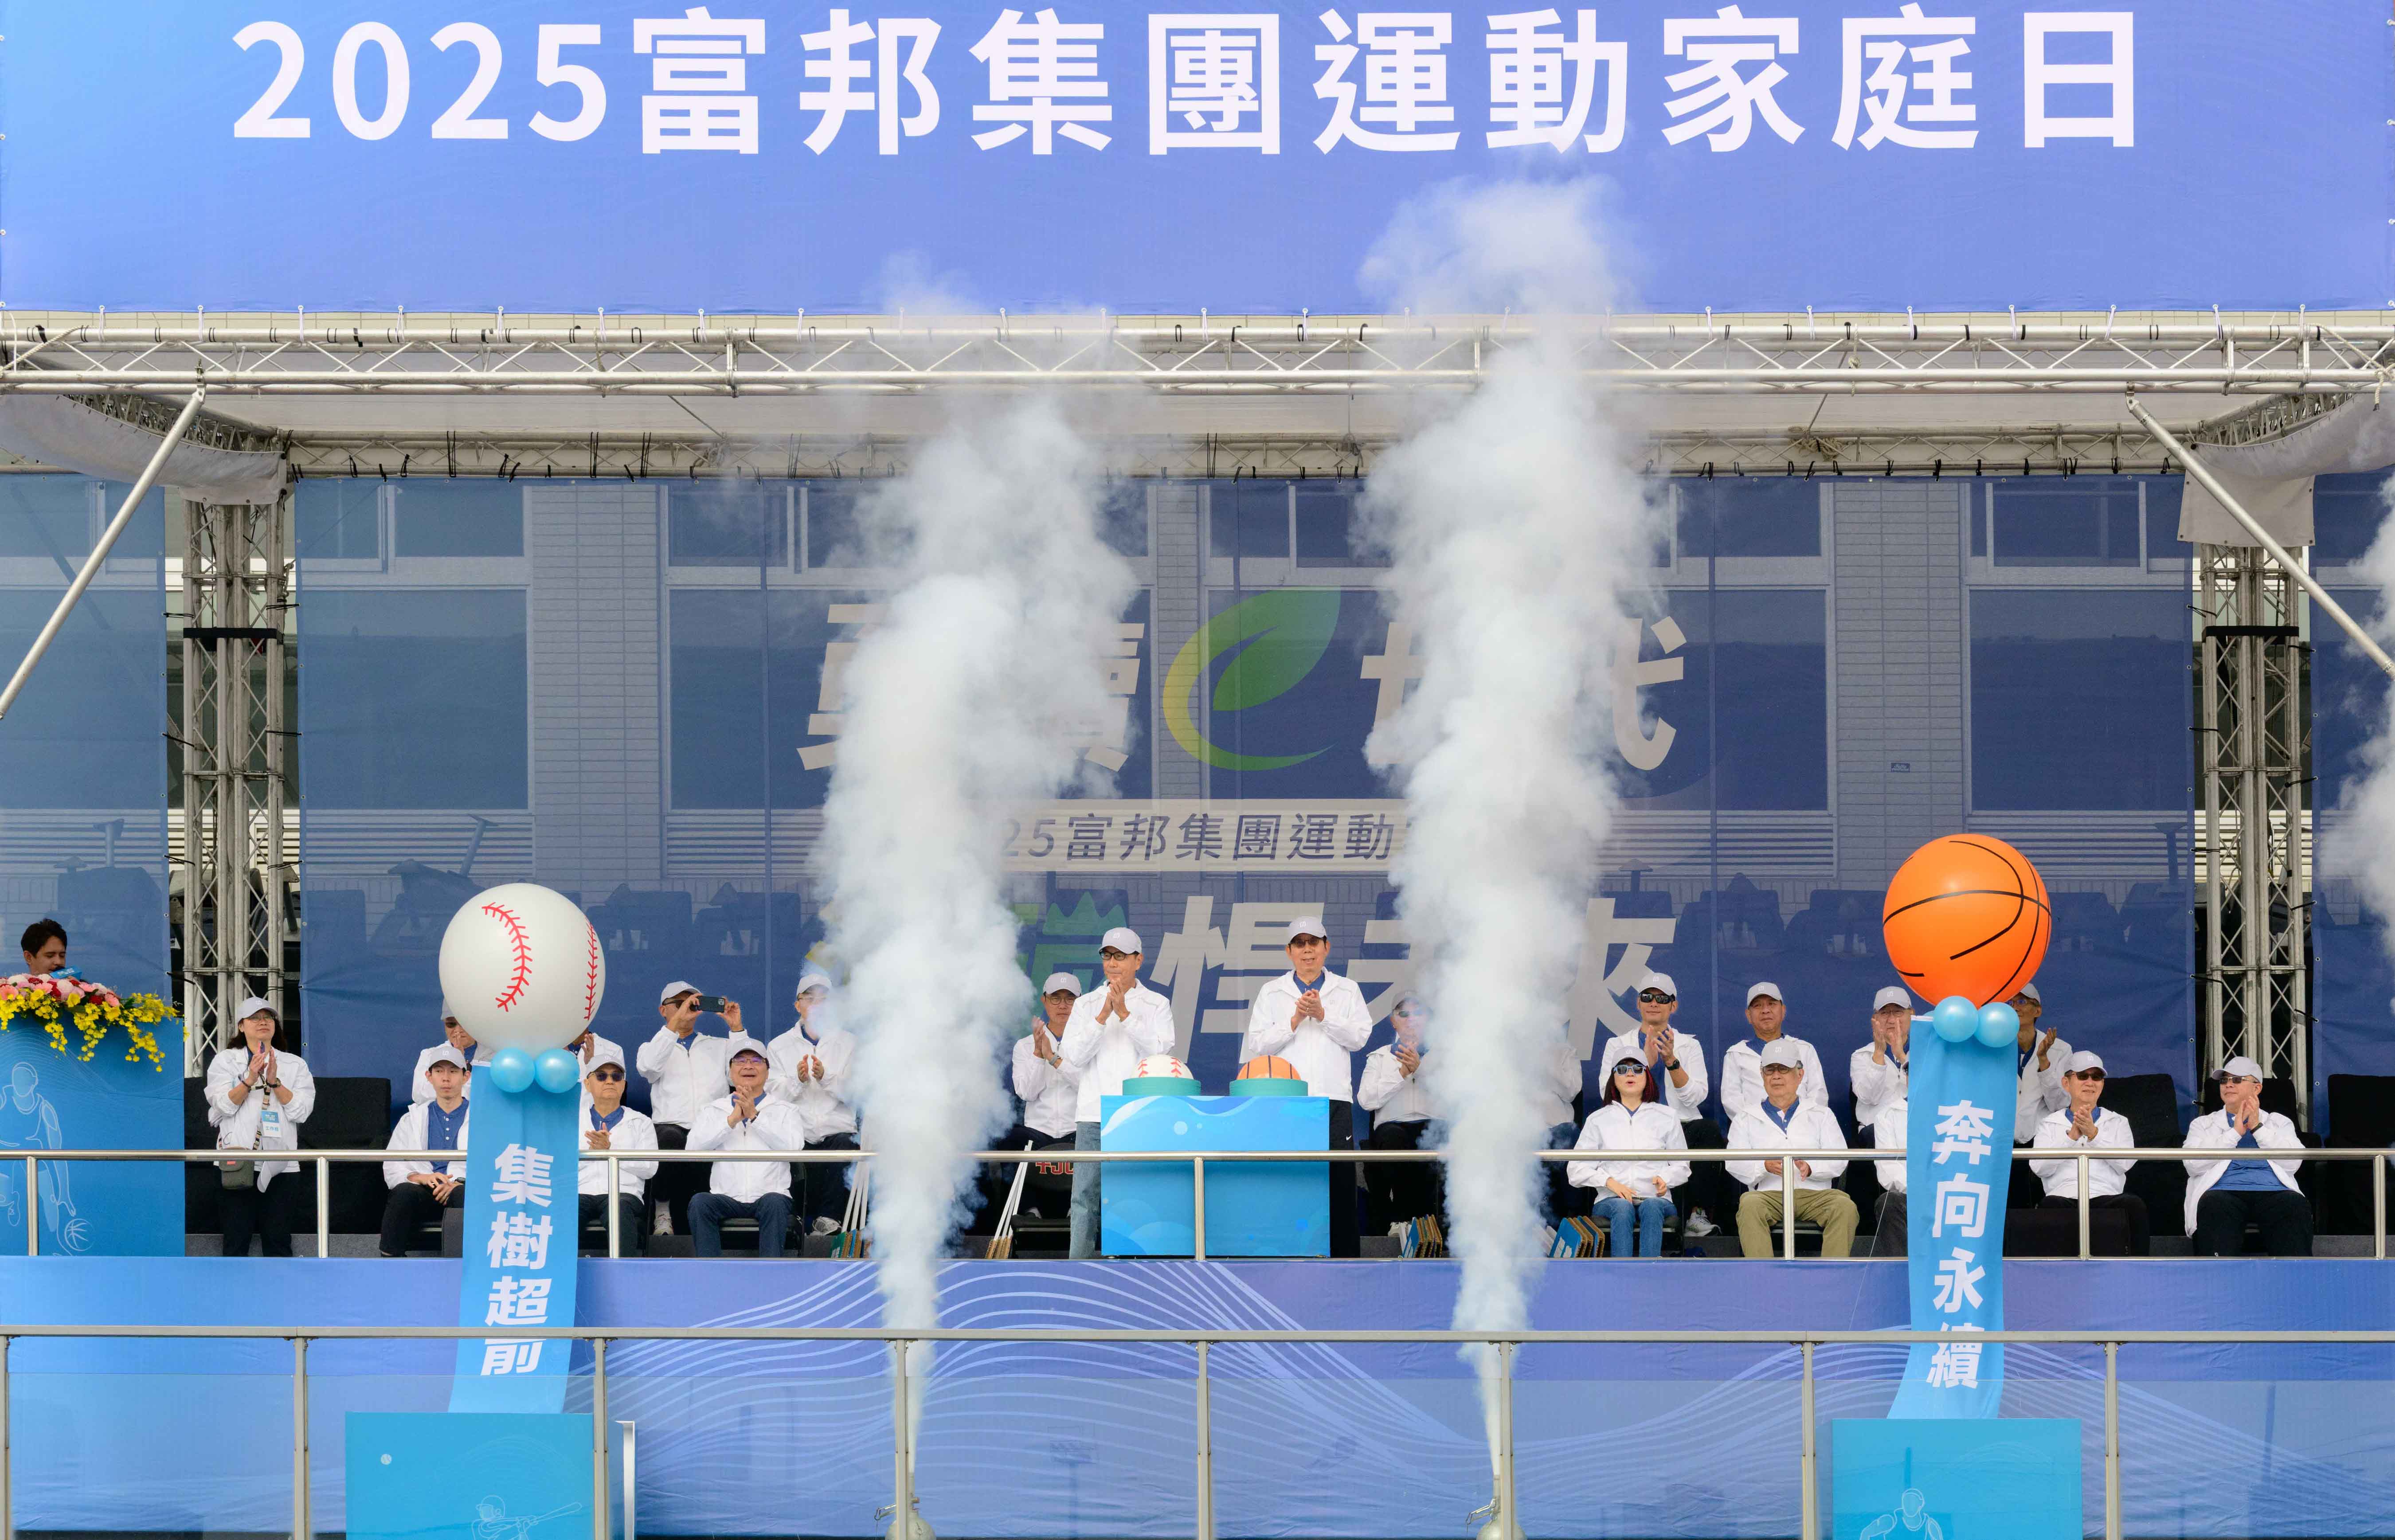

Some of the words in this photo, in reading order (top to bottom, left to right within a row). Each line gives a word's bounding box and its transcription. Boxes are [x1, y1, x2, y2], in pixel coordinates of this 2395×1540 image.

[233, 3, 2133, 155] 2025富邦集團運動家庭日
[481, 1143, 554, 1376] 集樹超前
[1926, 1100, 1994, 1389] 奔向永續
